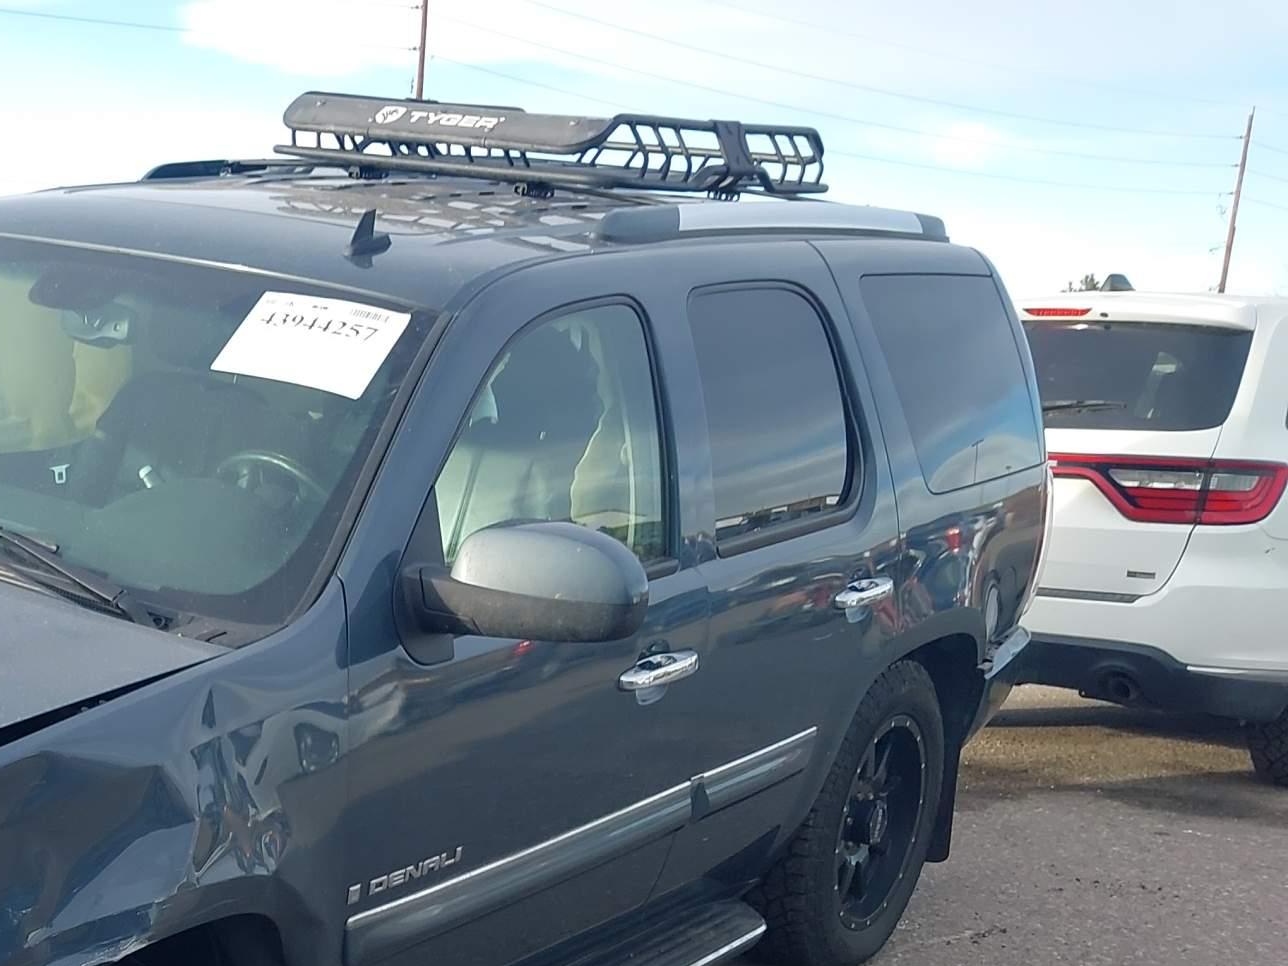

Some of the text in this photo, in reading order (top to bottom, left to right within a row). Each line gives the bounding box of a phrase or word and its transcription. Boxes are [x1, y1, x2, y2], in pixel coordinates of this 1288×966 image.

[410, 110, 499, 129] TYGER
[261, 311, 379, 342] 43944257
[369, 845, 463, 896] DENALI
